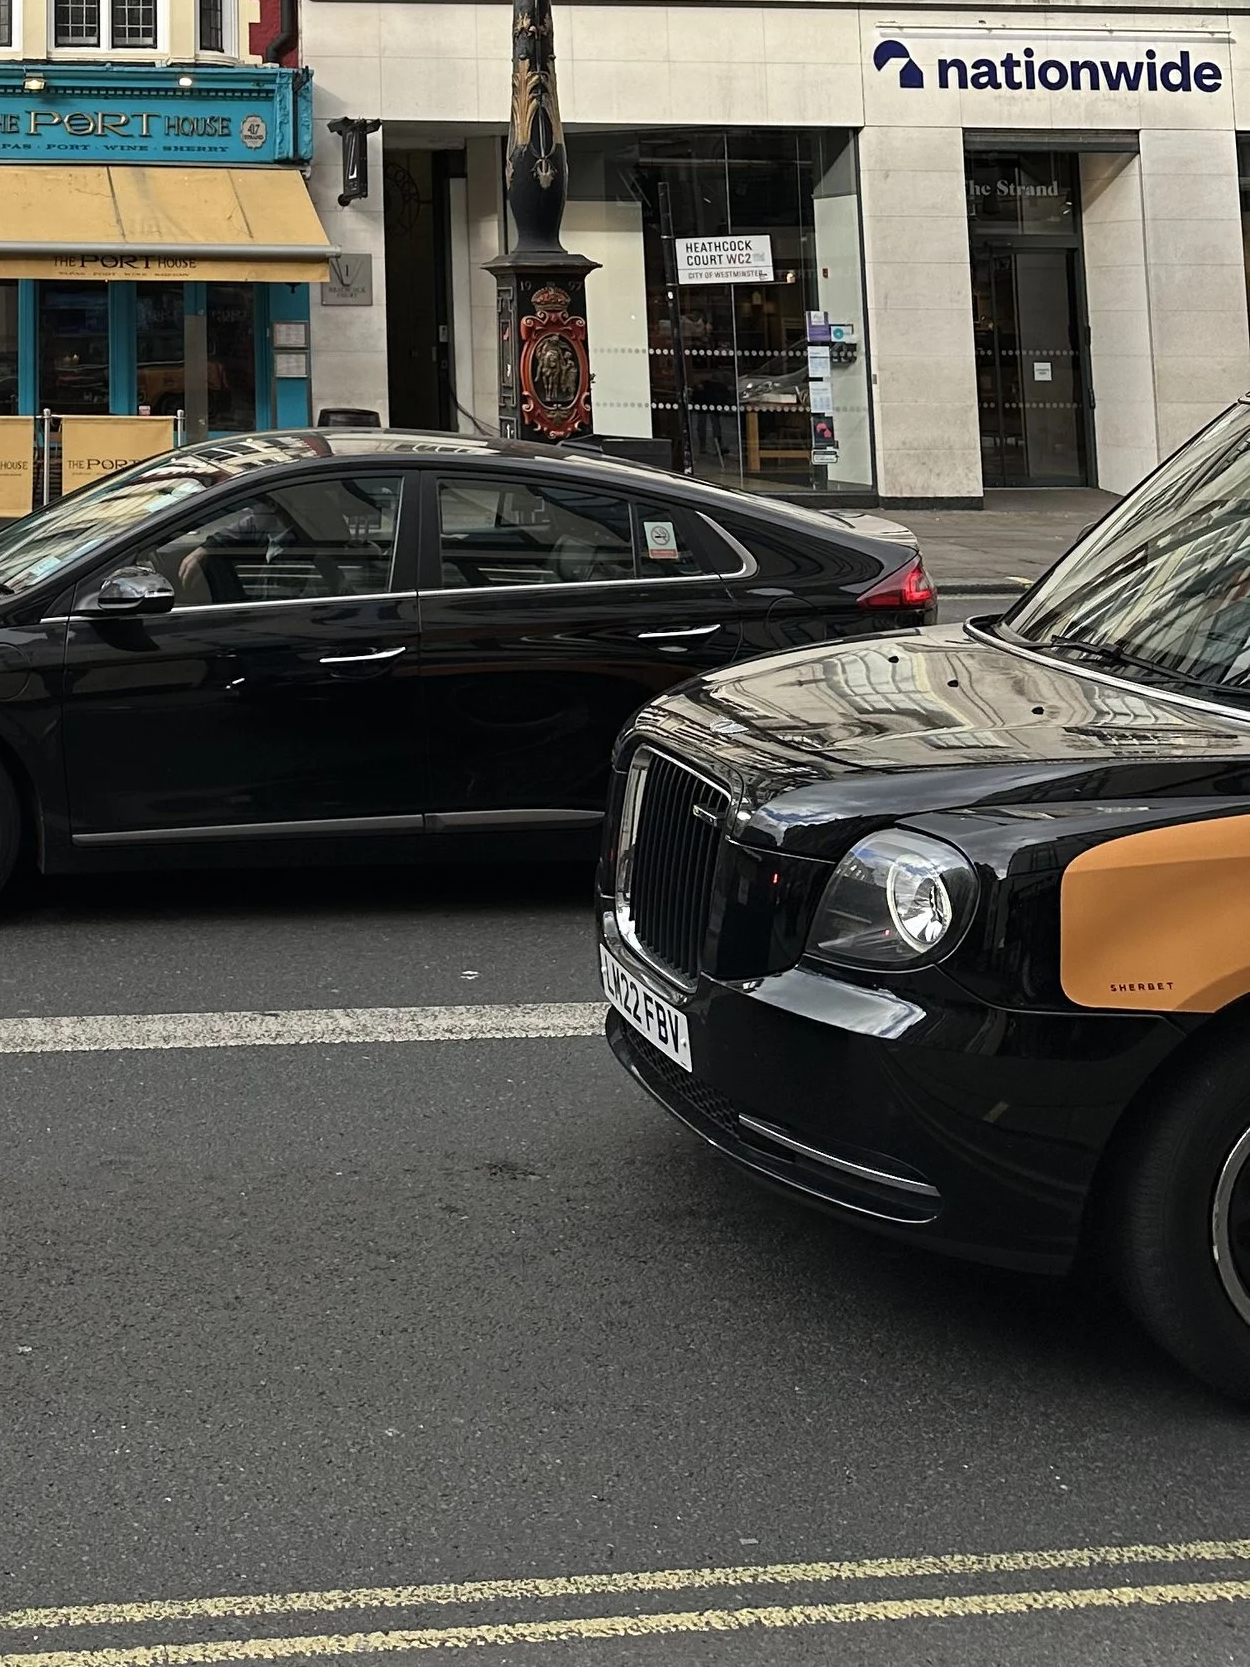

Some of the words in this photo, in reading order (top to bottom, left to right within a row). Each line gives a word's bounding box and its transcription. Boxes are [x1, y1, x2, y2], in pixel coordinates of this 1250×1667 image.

[937, 48, 1223, 93] nationwide
[24, 109, 162, 138] PORT
[164, 115, 232, 138] HOUSE
[46, 143, 91, 151] PORT
[103, 144, 149, 152] WINE
[162, 145, 229, 153] SHERRY
[966, 179, 991, 196] he
[996, 179, 1059, 196] Strand
[685, 240, 753, 253] HEATHCOCK
[53, 255, 77, 267] THE
[80, 254, 155, 269] PORT
[157, 255, 197, 269] HOUSE
[686, 254, 723, 266] COURT
[726, 253, 752, 264] WC2
[705, 271, 712, 279] OF
[0, 460, 29, 470] HOUSE
[67, 460, 85, 469] THE
[1110, 982, 1174, 992] SHERBET
